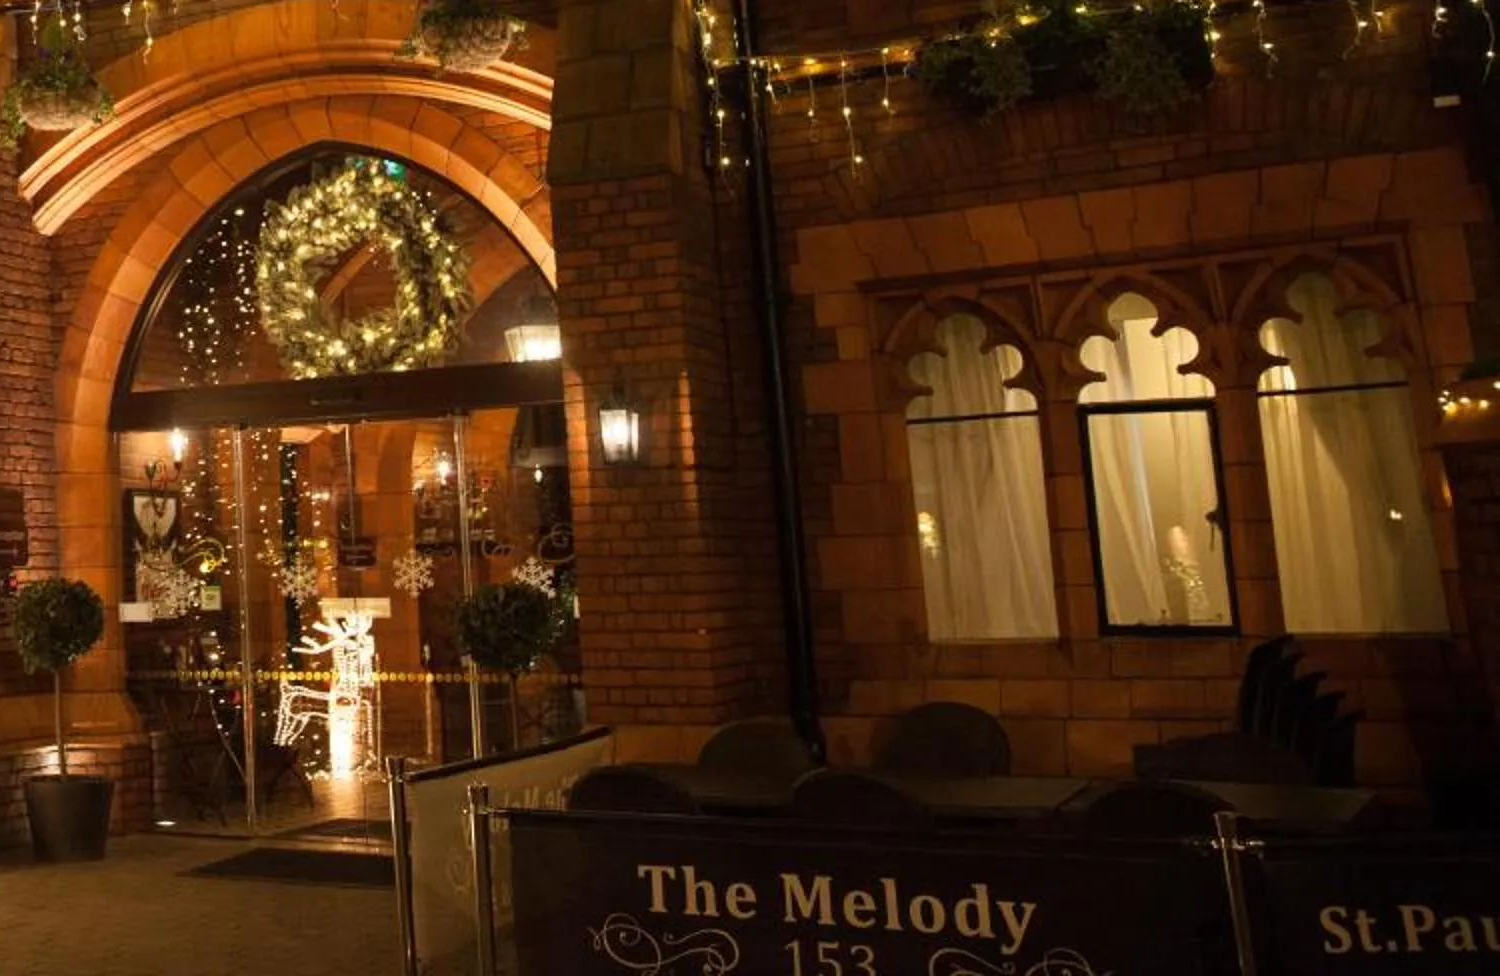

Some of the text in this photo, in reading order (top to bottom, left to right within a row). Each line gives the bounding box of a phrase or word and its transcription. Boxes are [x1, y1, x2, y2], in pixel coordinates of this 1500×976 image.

[636, 863, 1038, 956] The Melody
[783, 938, 878, 976] 153
